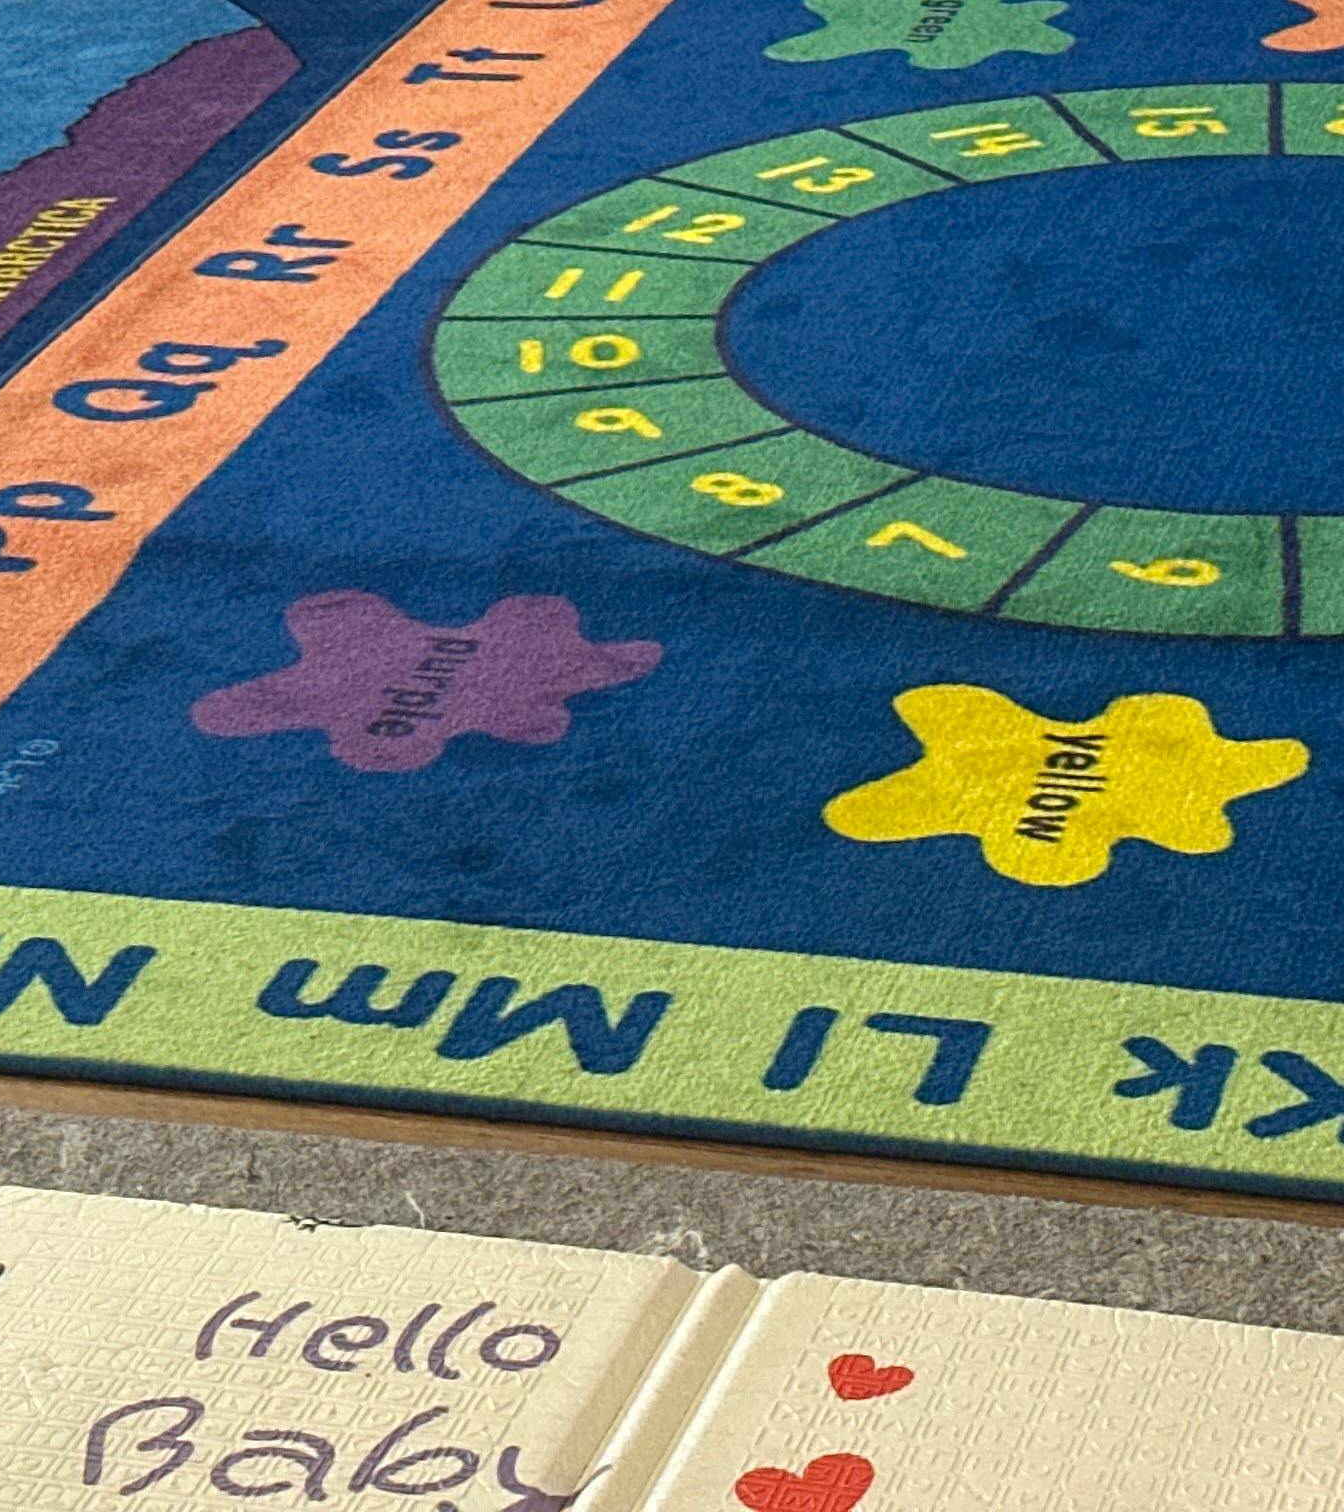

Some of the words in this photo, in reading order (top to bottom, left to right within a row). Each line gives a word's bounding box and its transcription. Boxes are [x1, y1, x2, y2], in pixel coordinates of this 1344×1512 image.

[902, 0, 965, 43] green
[929, 123, 1043, 159] 14
[1127, 106, 1229, 139] 15
[757, 156, 875, 195] 13
[51, 337, 287, 423] Qq
[193, 222, 354, 284] Rr
[309, 127, 463, 181] Ss
[403, 46, 546, 85] Tt
[623, 205, 746, 245] 12
[543, 268, 646, 302] 11
[519, 333, 642, 374] 10
[574, 406, 663, 440] 9
[690, 471, 786, 507] 8
[865, 521, 967, 560] 7
[1109, 557, 1221, 587] 6
[367, 637, 480, 738] purple
[1015, 733, 1108, 843] yellow
[256, 958, 673, 1076] Mm
[761, 1007, 993, 1107] Ll
[195, 1290, 561, 1380] Hello
[82, 1396, 611, 1512] Baby
